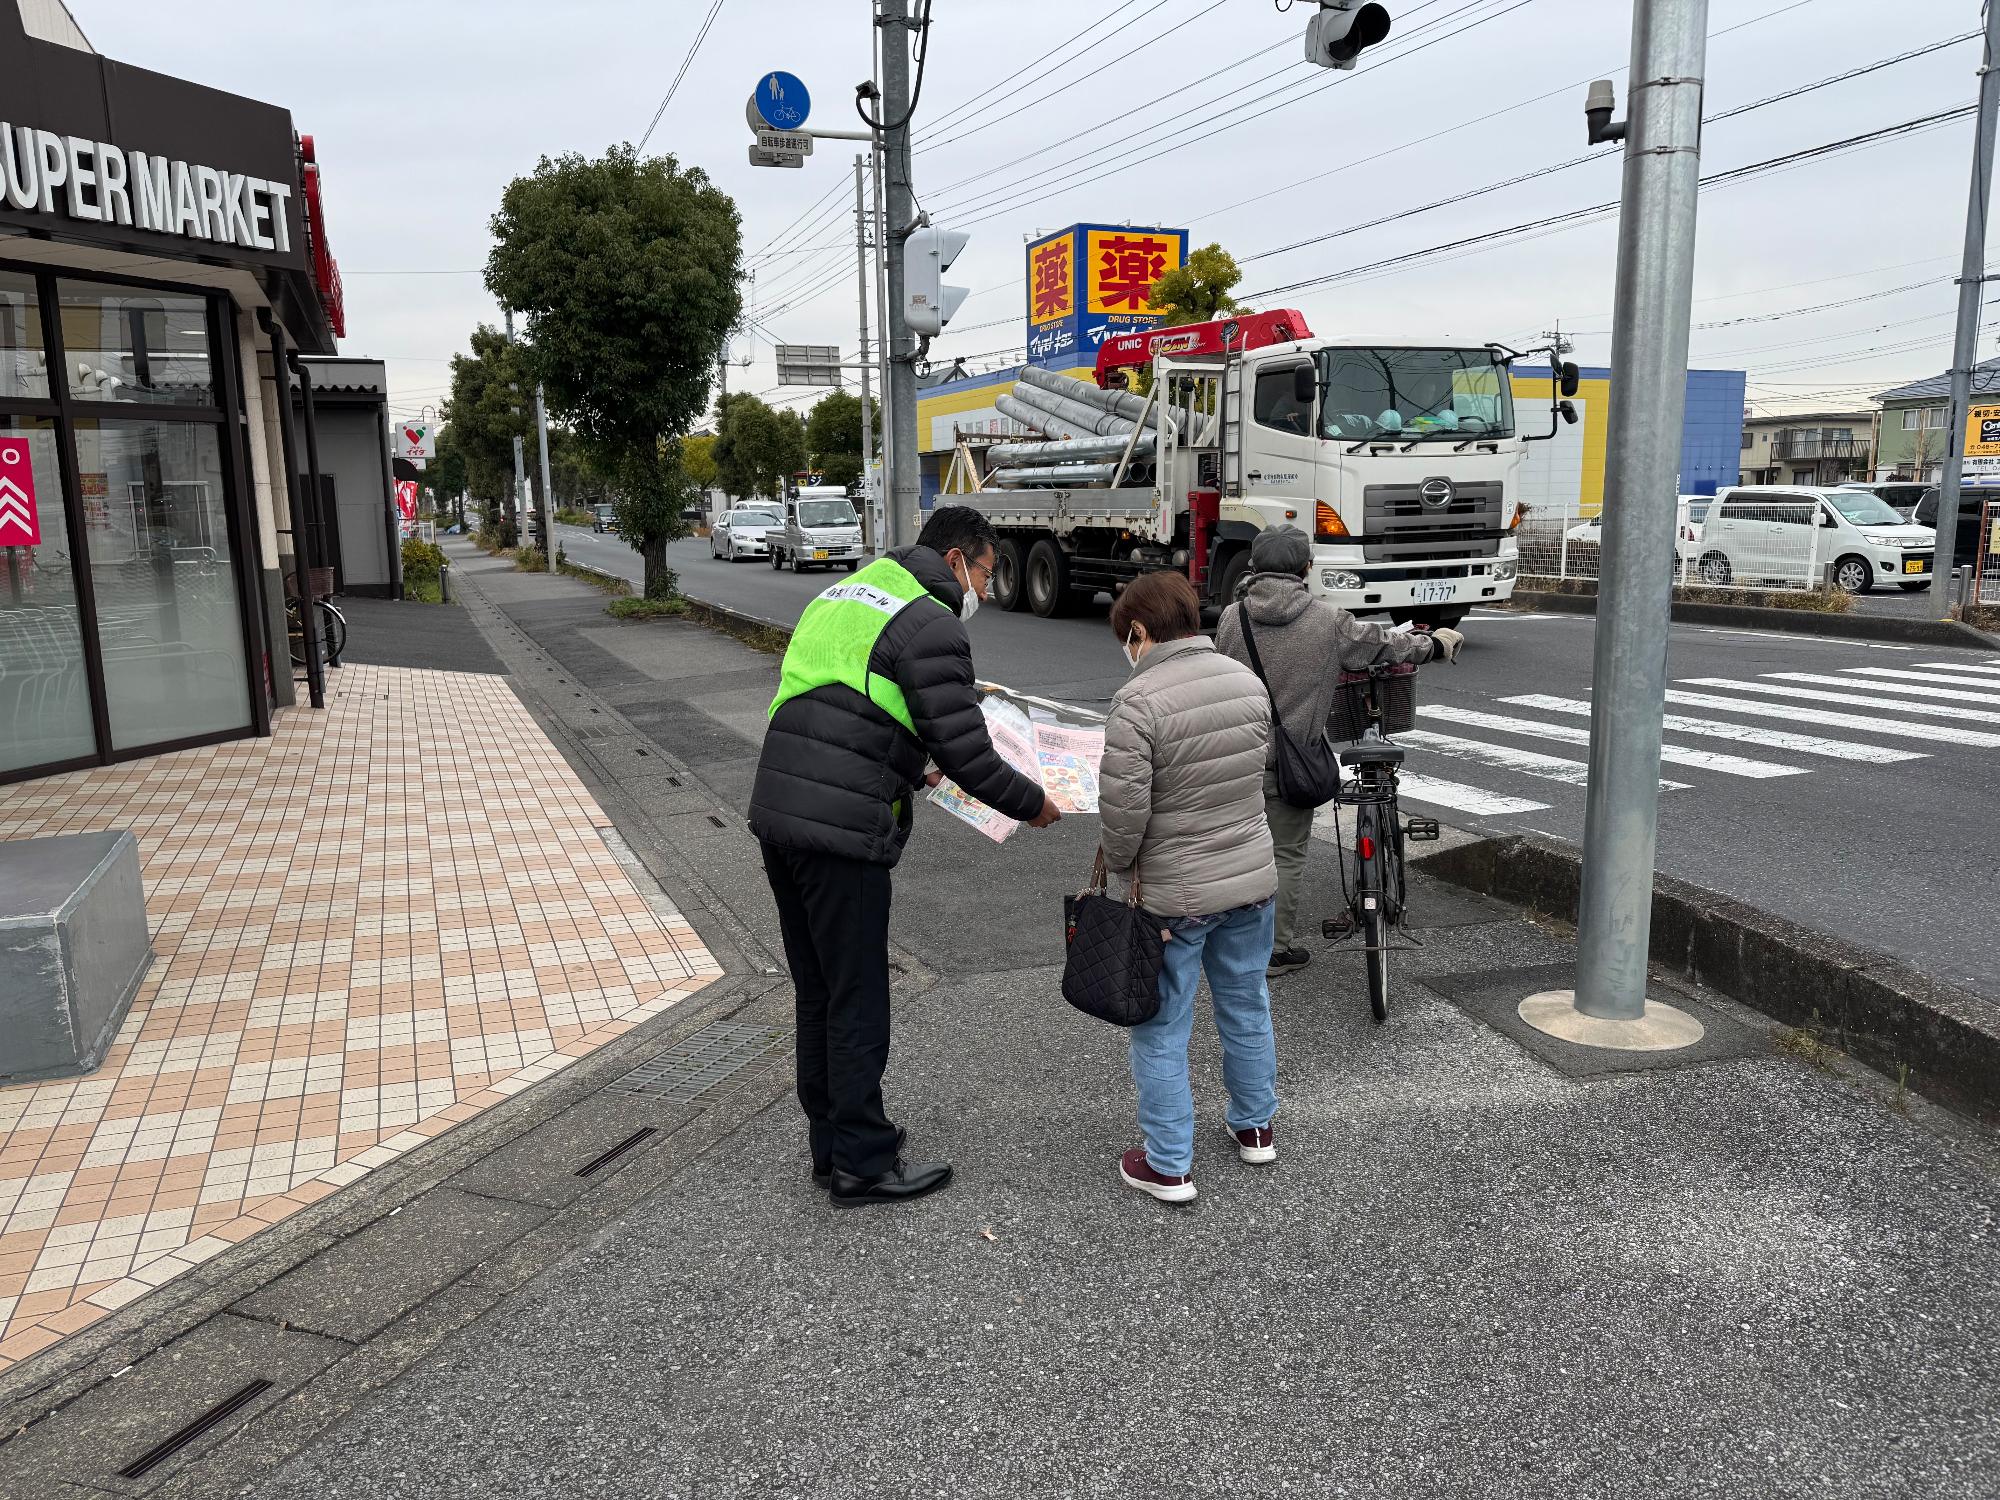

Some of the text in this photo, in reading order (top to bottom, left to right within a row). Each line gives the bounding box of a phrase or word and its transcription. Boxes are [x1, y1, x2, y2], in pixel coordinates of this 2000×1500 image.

[128, 150, 292, 252] MARKET
[1035, 242, 1068, 318] 薬
[1098, 235, 1168, 310] 薬
[1108, 315, 1158, 325] DRUG STORE
[1117, 338, 1143, 351] UNIC
[1423, 586, 1452, 601] 17-77
